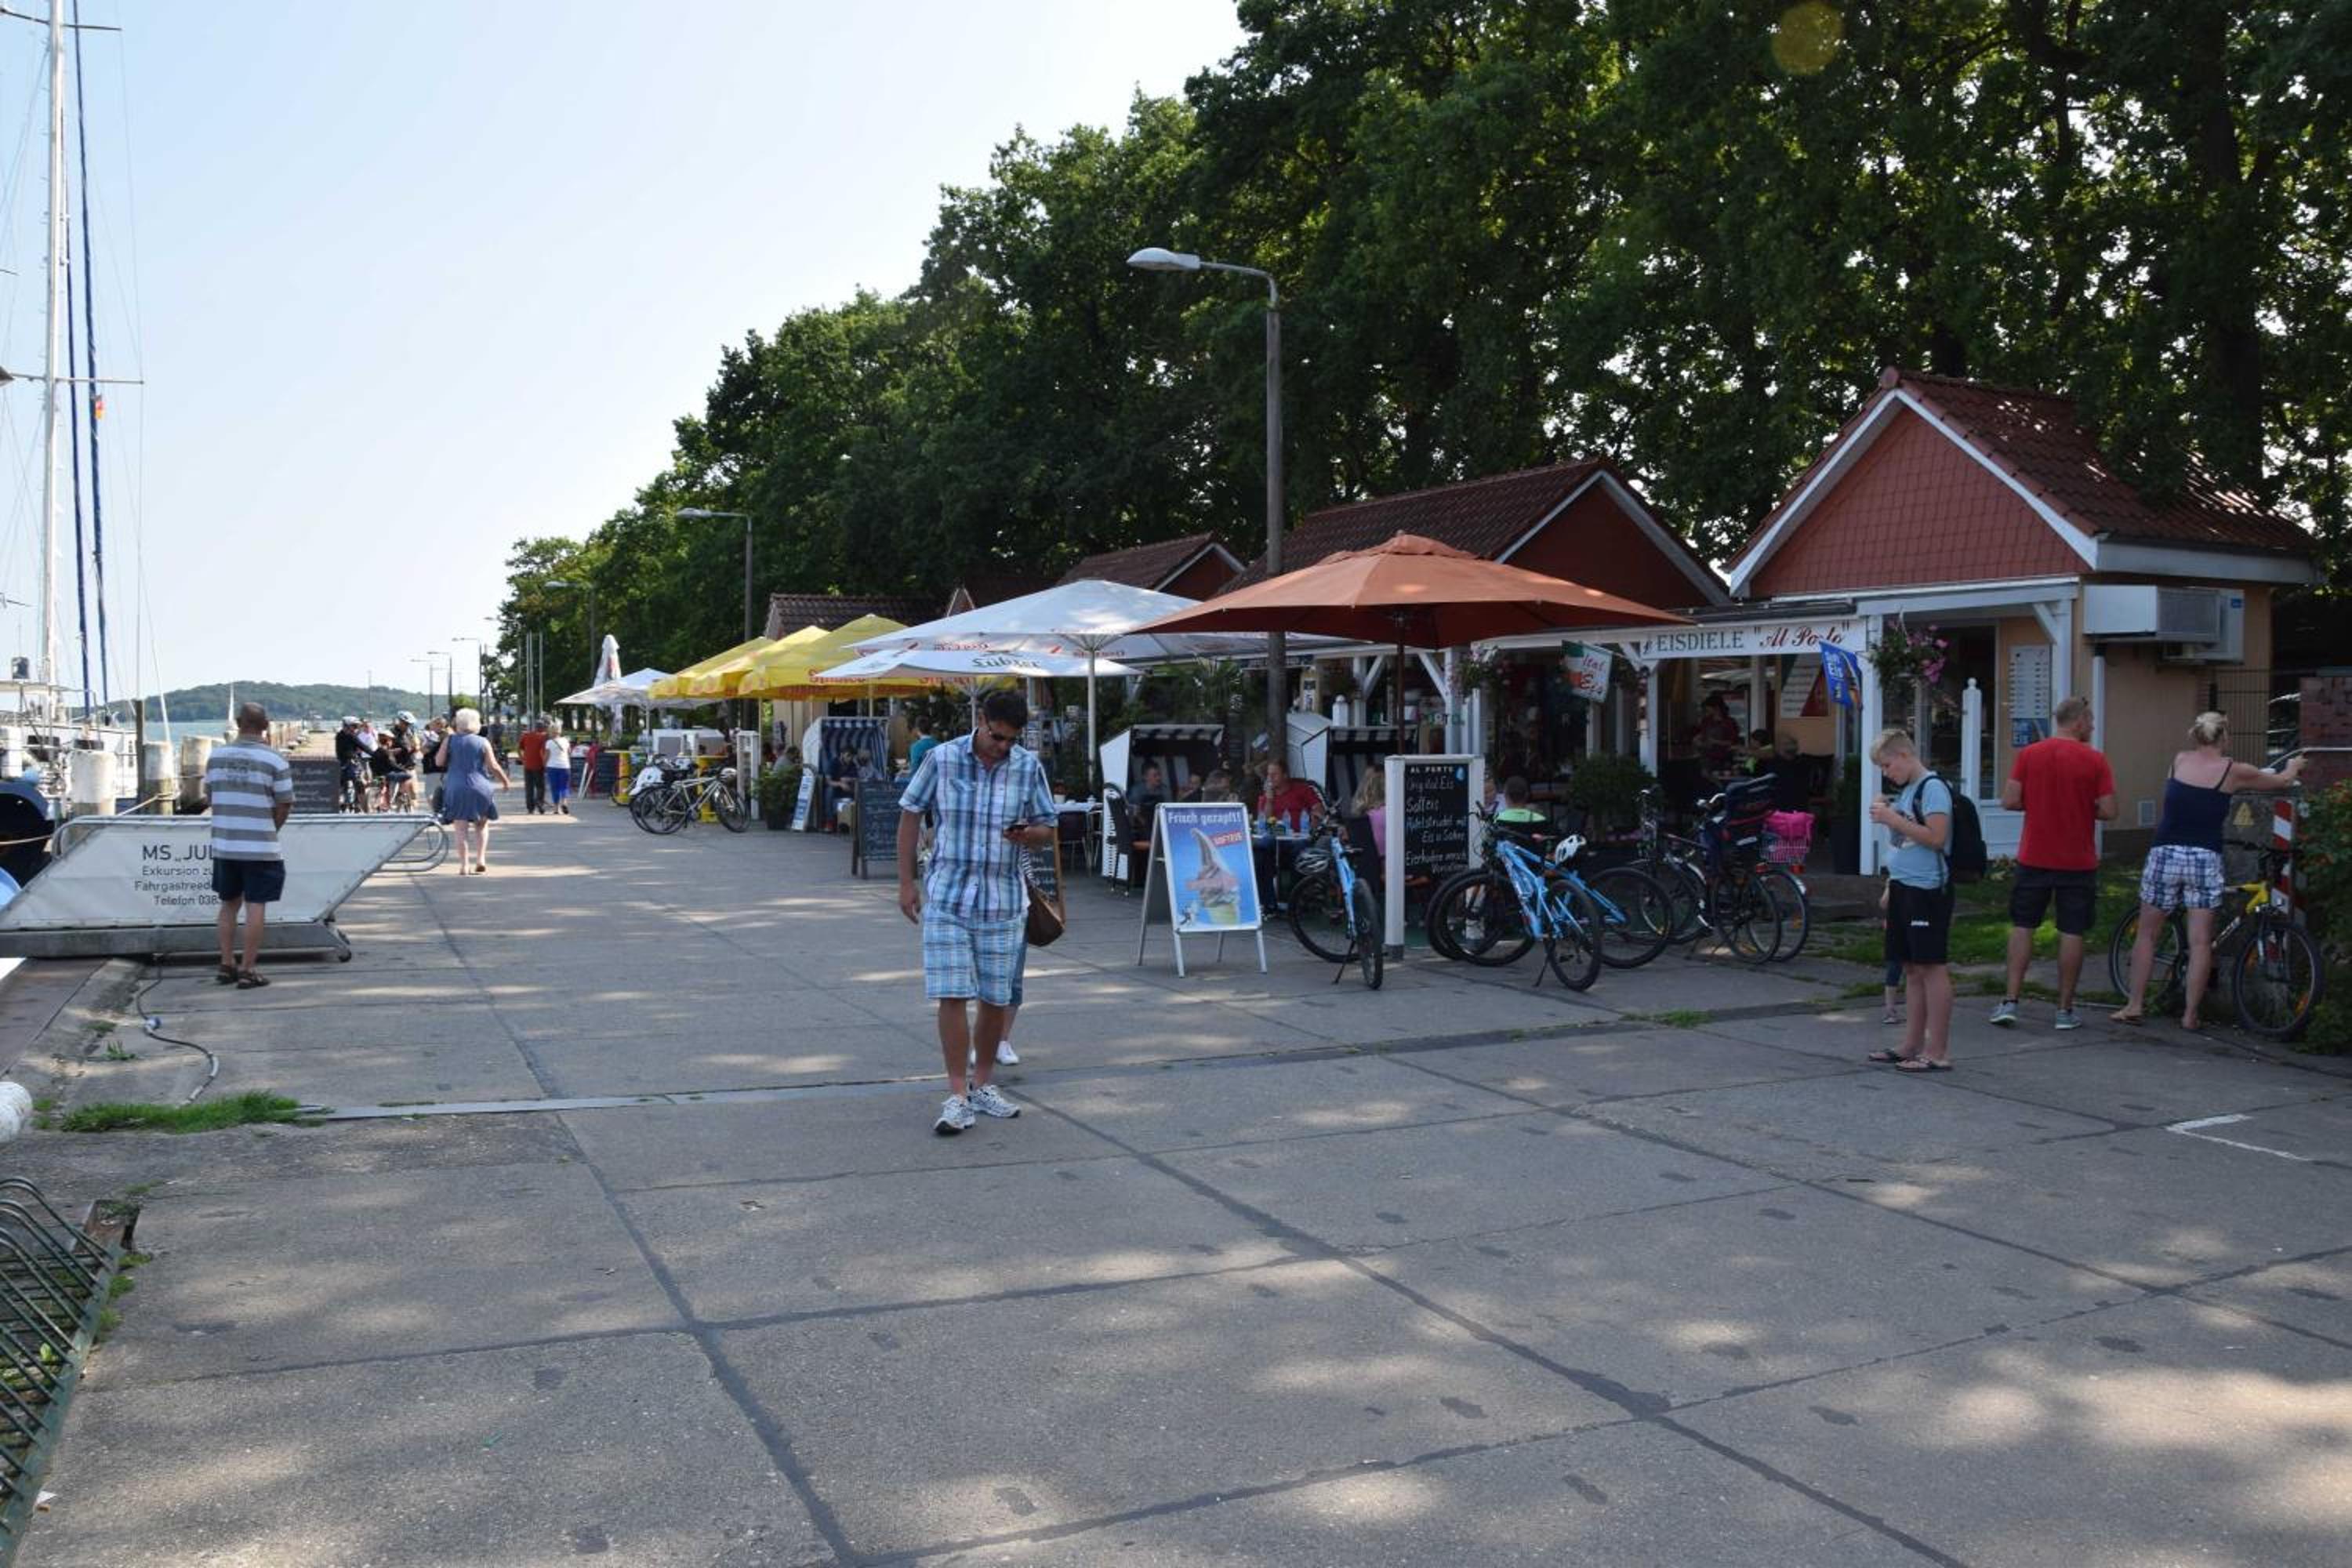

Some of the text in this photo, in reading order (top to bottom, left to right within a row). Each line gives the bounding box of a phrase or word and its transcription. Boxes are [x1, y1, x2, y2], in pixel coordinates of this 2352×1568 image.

[1657, 630, 1744, 652] EISDIELE
[1167, 811, 1198, 824] Frisch
[143, 844, 172, 861] MS
[142, 866, 200, 877] Exkursion
[153, 895, 195, 906] Telefon
